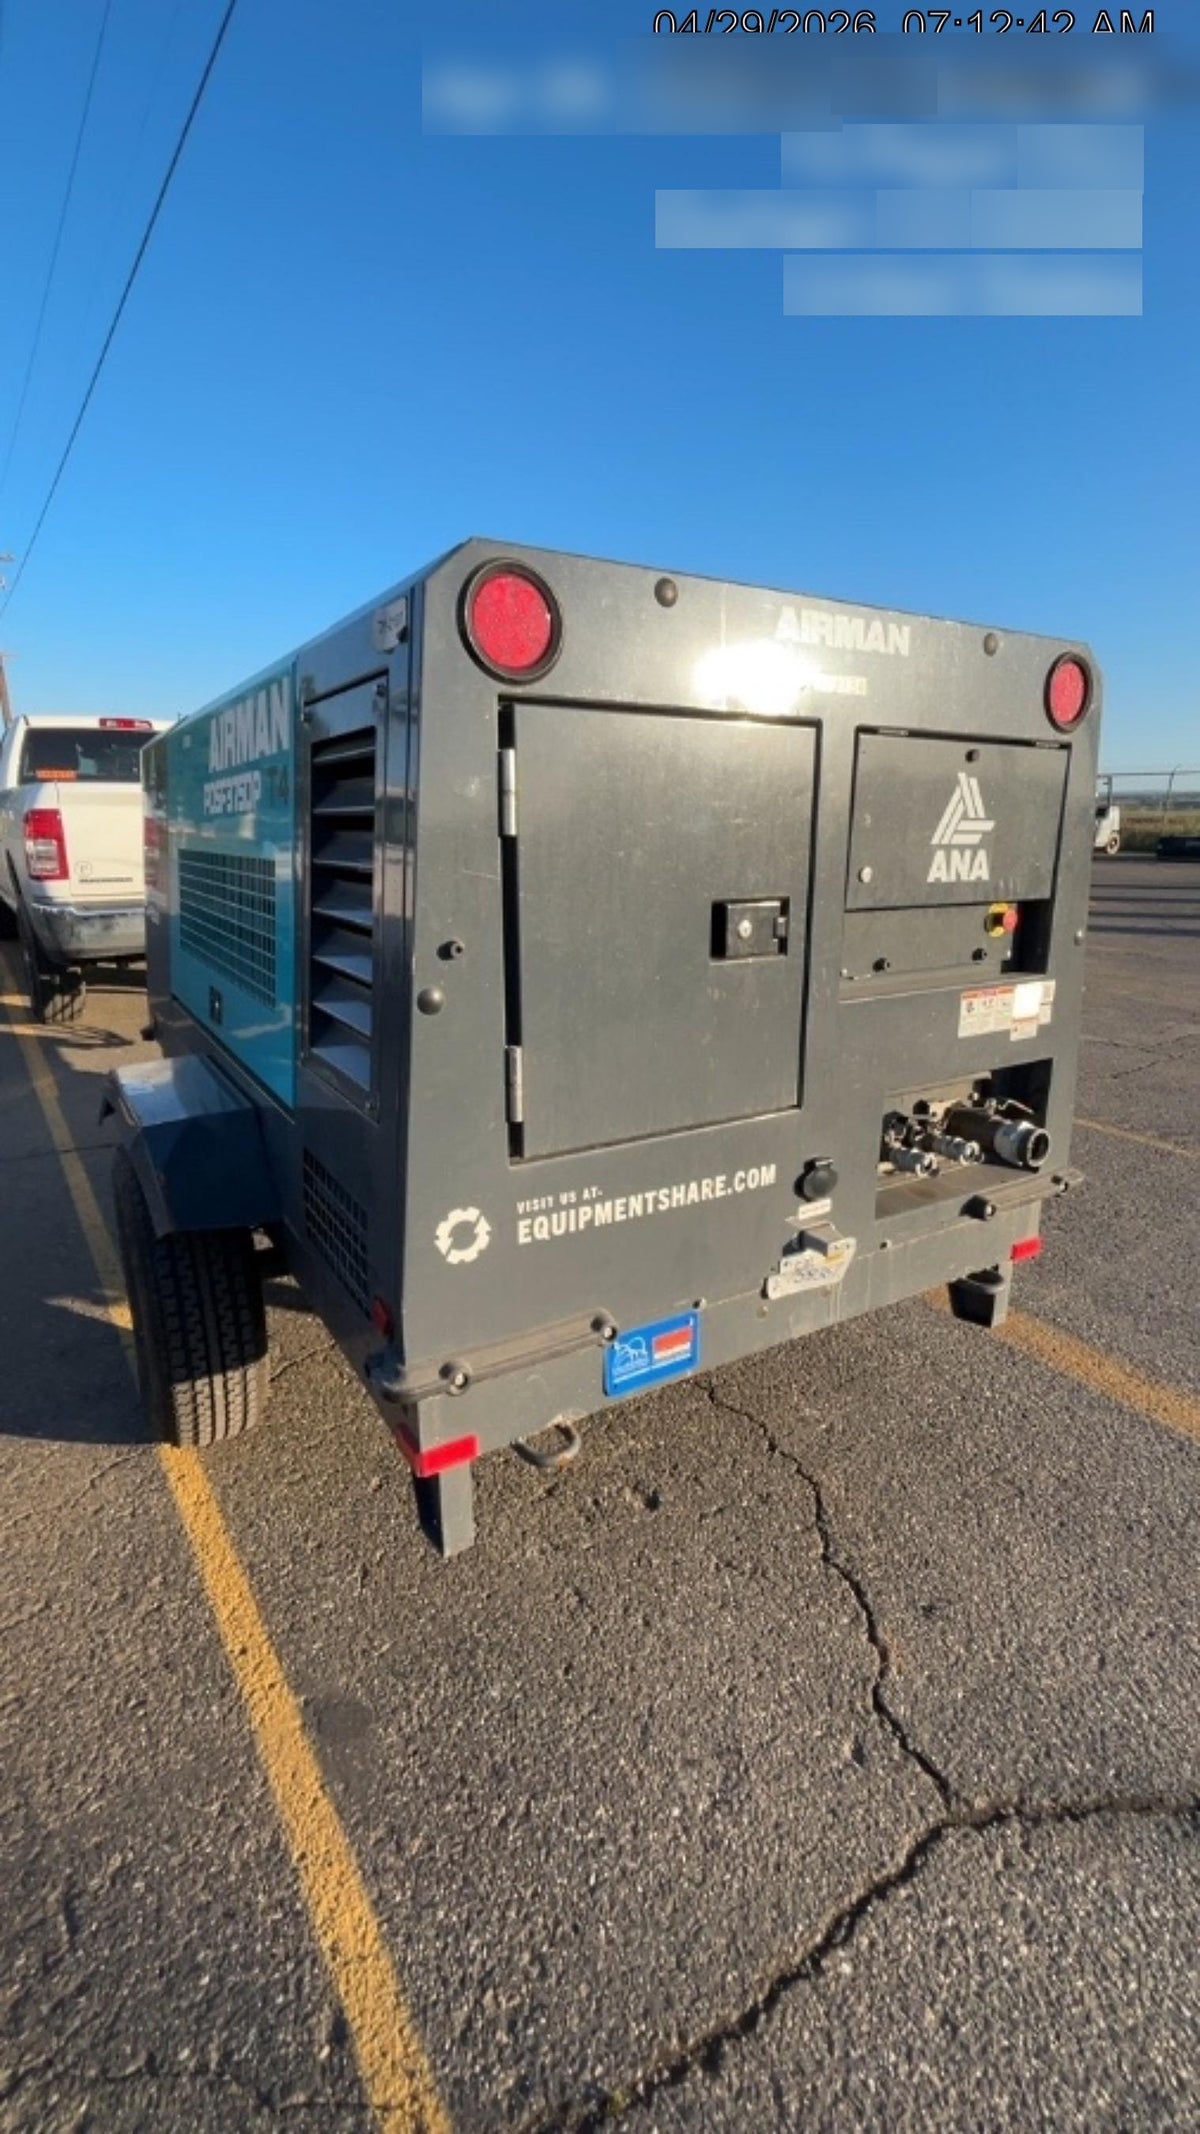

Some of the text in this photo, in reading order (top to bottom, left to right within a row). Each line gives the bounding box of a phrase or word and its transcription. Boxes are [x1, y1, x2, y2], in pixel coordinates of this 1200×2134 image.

[775, 606, 911, 656] AIRMAN
[209, 677, 290, 773] AIRMAN
[927, 849, 990, 883] ANA
[516, 1195, 554, 1214] VISIT
[559, 1191, 577, 1205] US
[517, 1163, 777, 1245] EQUIPMENTSHARE.COM
